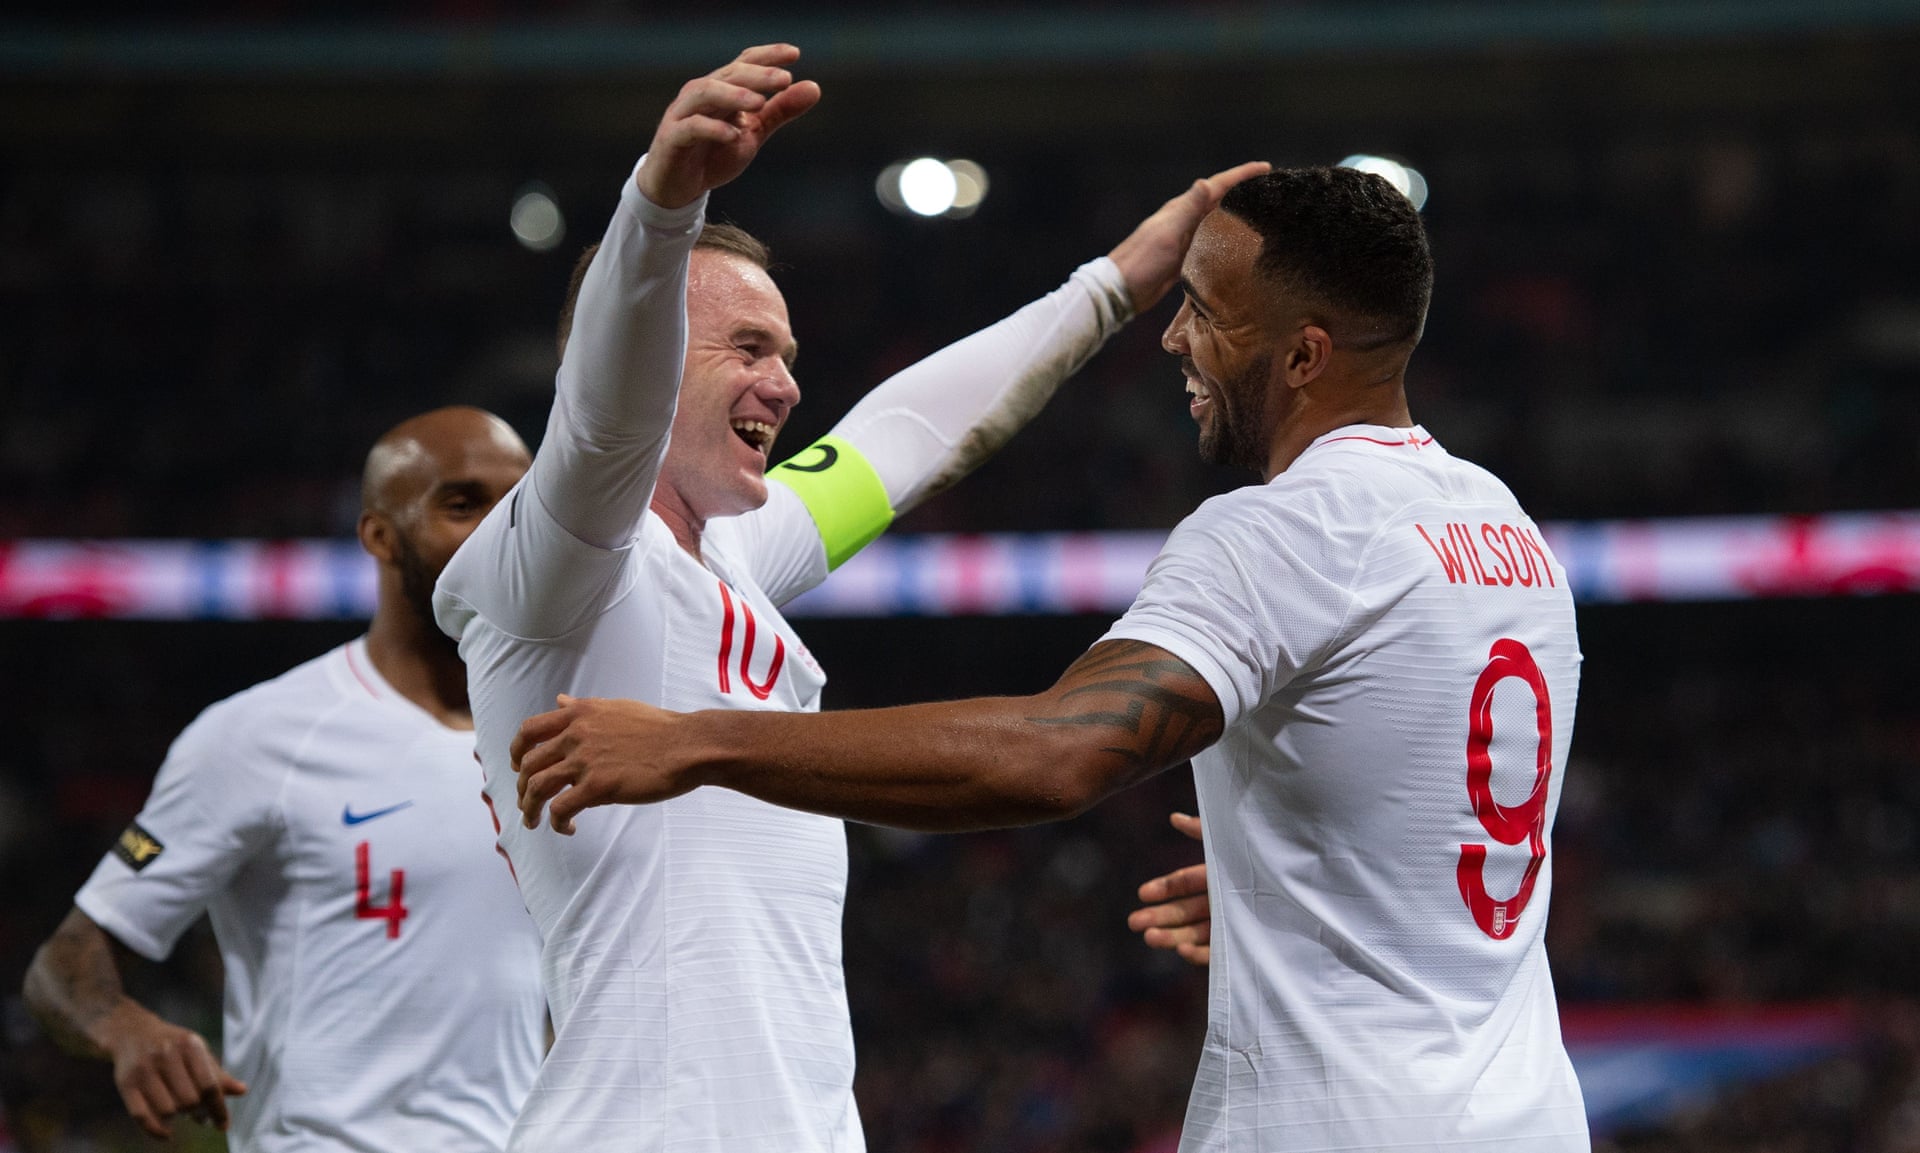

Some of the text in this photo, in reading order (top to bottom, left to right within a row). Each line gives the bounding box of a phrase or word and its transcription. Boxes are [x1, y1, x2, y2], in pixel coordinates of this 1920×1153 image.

[1415, 522, 1555, 588] WILSON
[718, 580, 785, 700] 10
[1456, 637, 1553, 941] 9
[355, 841, 409, 940] 4
